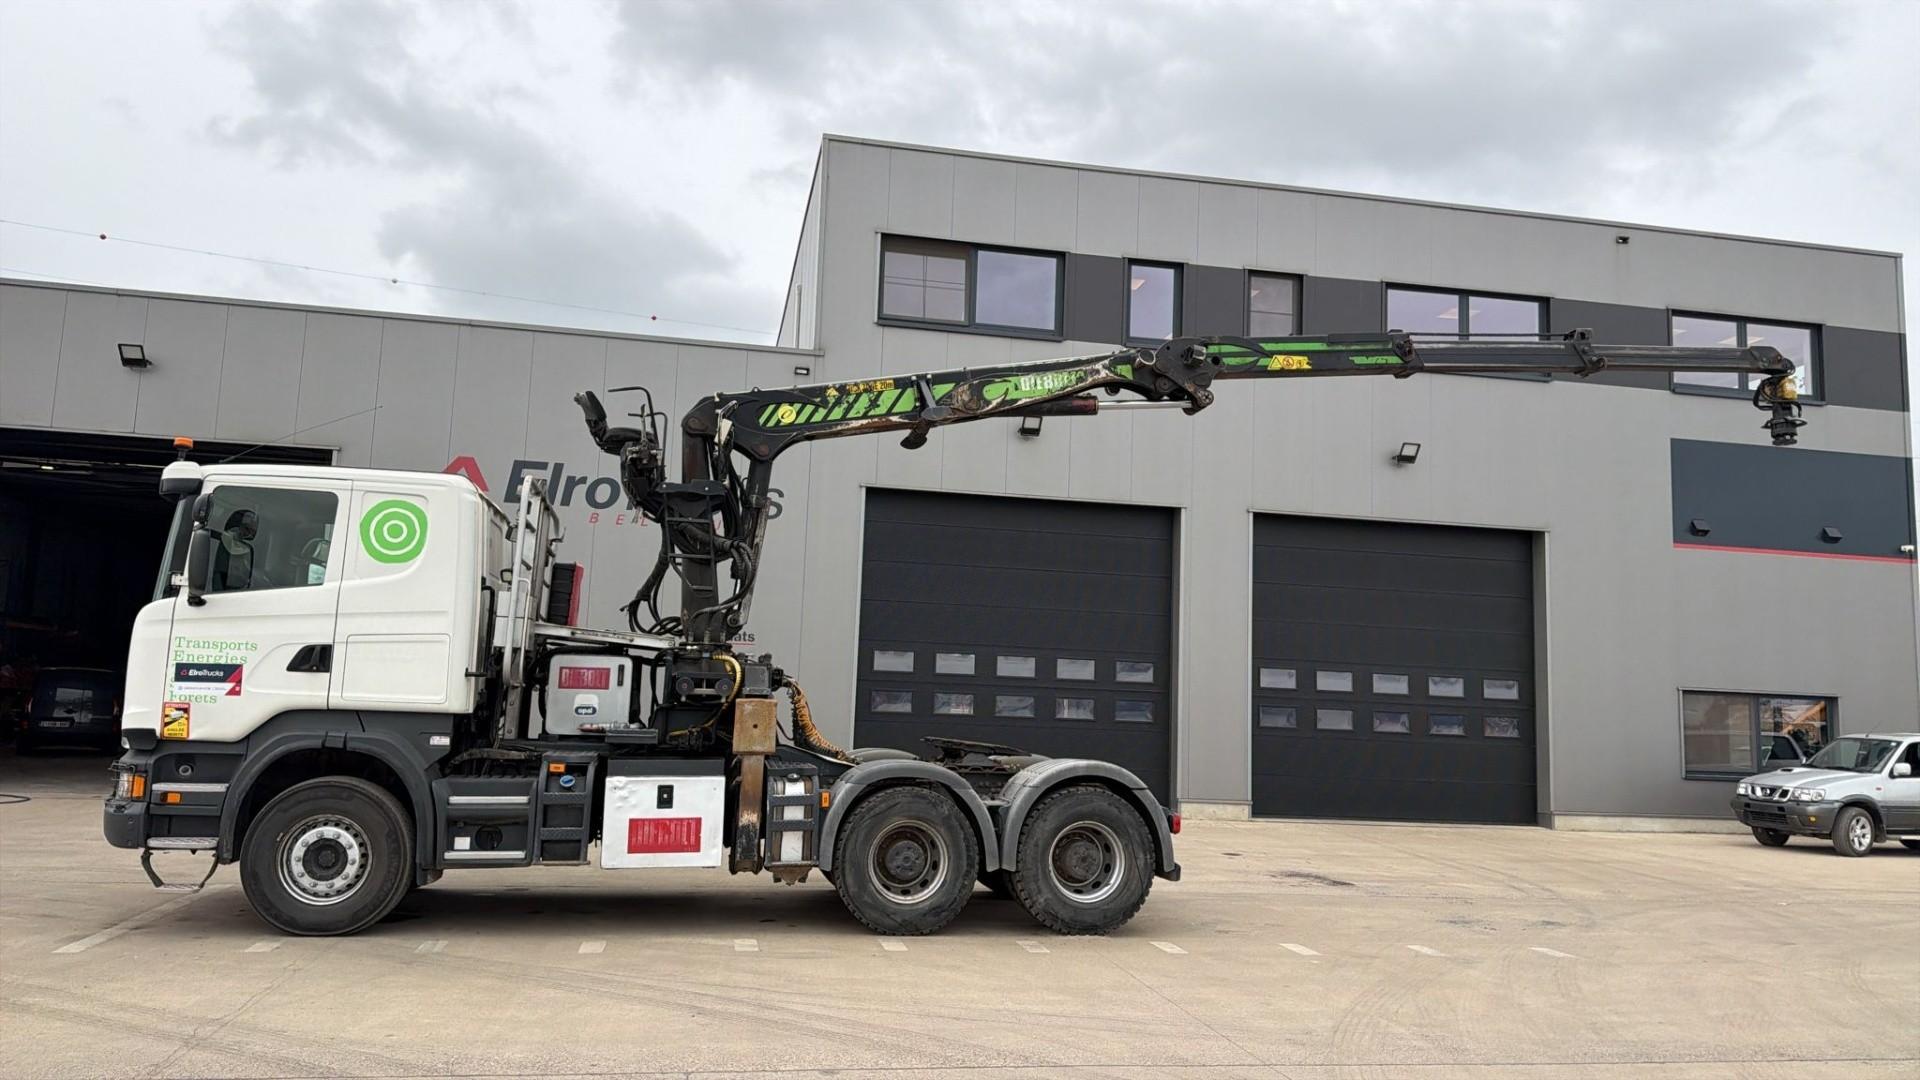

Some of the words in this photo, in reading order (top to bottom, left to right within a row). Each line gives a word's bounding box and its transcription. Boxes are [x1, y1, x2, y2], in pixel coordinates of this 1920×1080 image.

[503, 459, 784, 520] Elros
[174, 636, 258, 653] Transports
[172, 649, 248, 664] Energies
[188, 668, 224, 677] ElroTrucks
